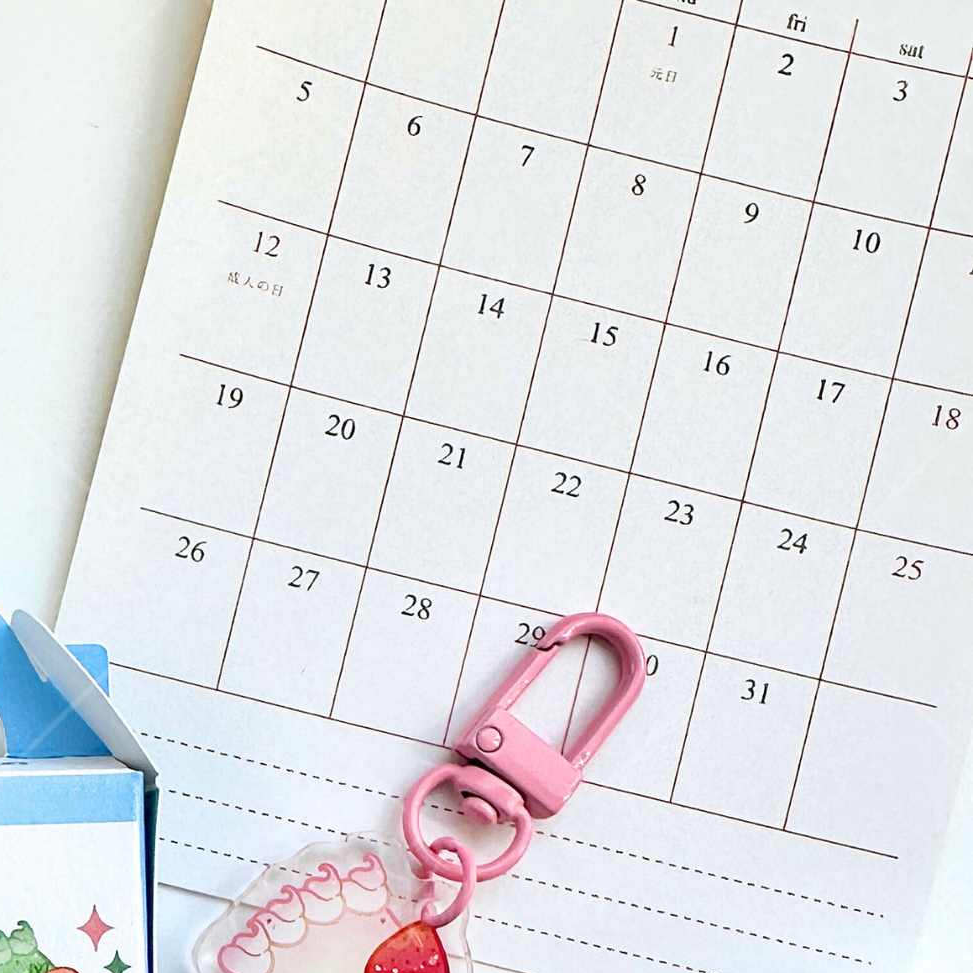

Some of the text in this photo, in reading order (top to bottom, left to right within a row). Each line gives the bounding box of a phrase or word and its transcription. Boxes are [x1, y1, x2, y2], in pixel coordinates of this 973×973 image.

[667, 25, 909, 102] 1 2 3
[786, 13, 808, 33] fri
[295, 80, 881, 254] 5 6 7 8 9 10
[253, 231, 962, 431] 12 13 14 15 16 17 18
[215, 383, 925, 581] 19 20 21 22 23 24 25
[174, 535, 770, 705] 26 27 28 29 0 31
